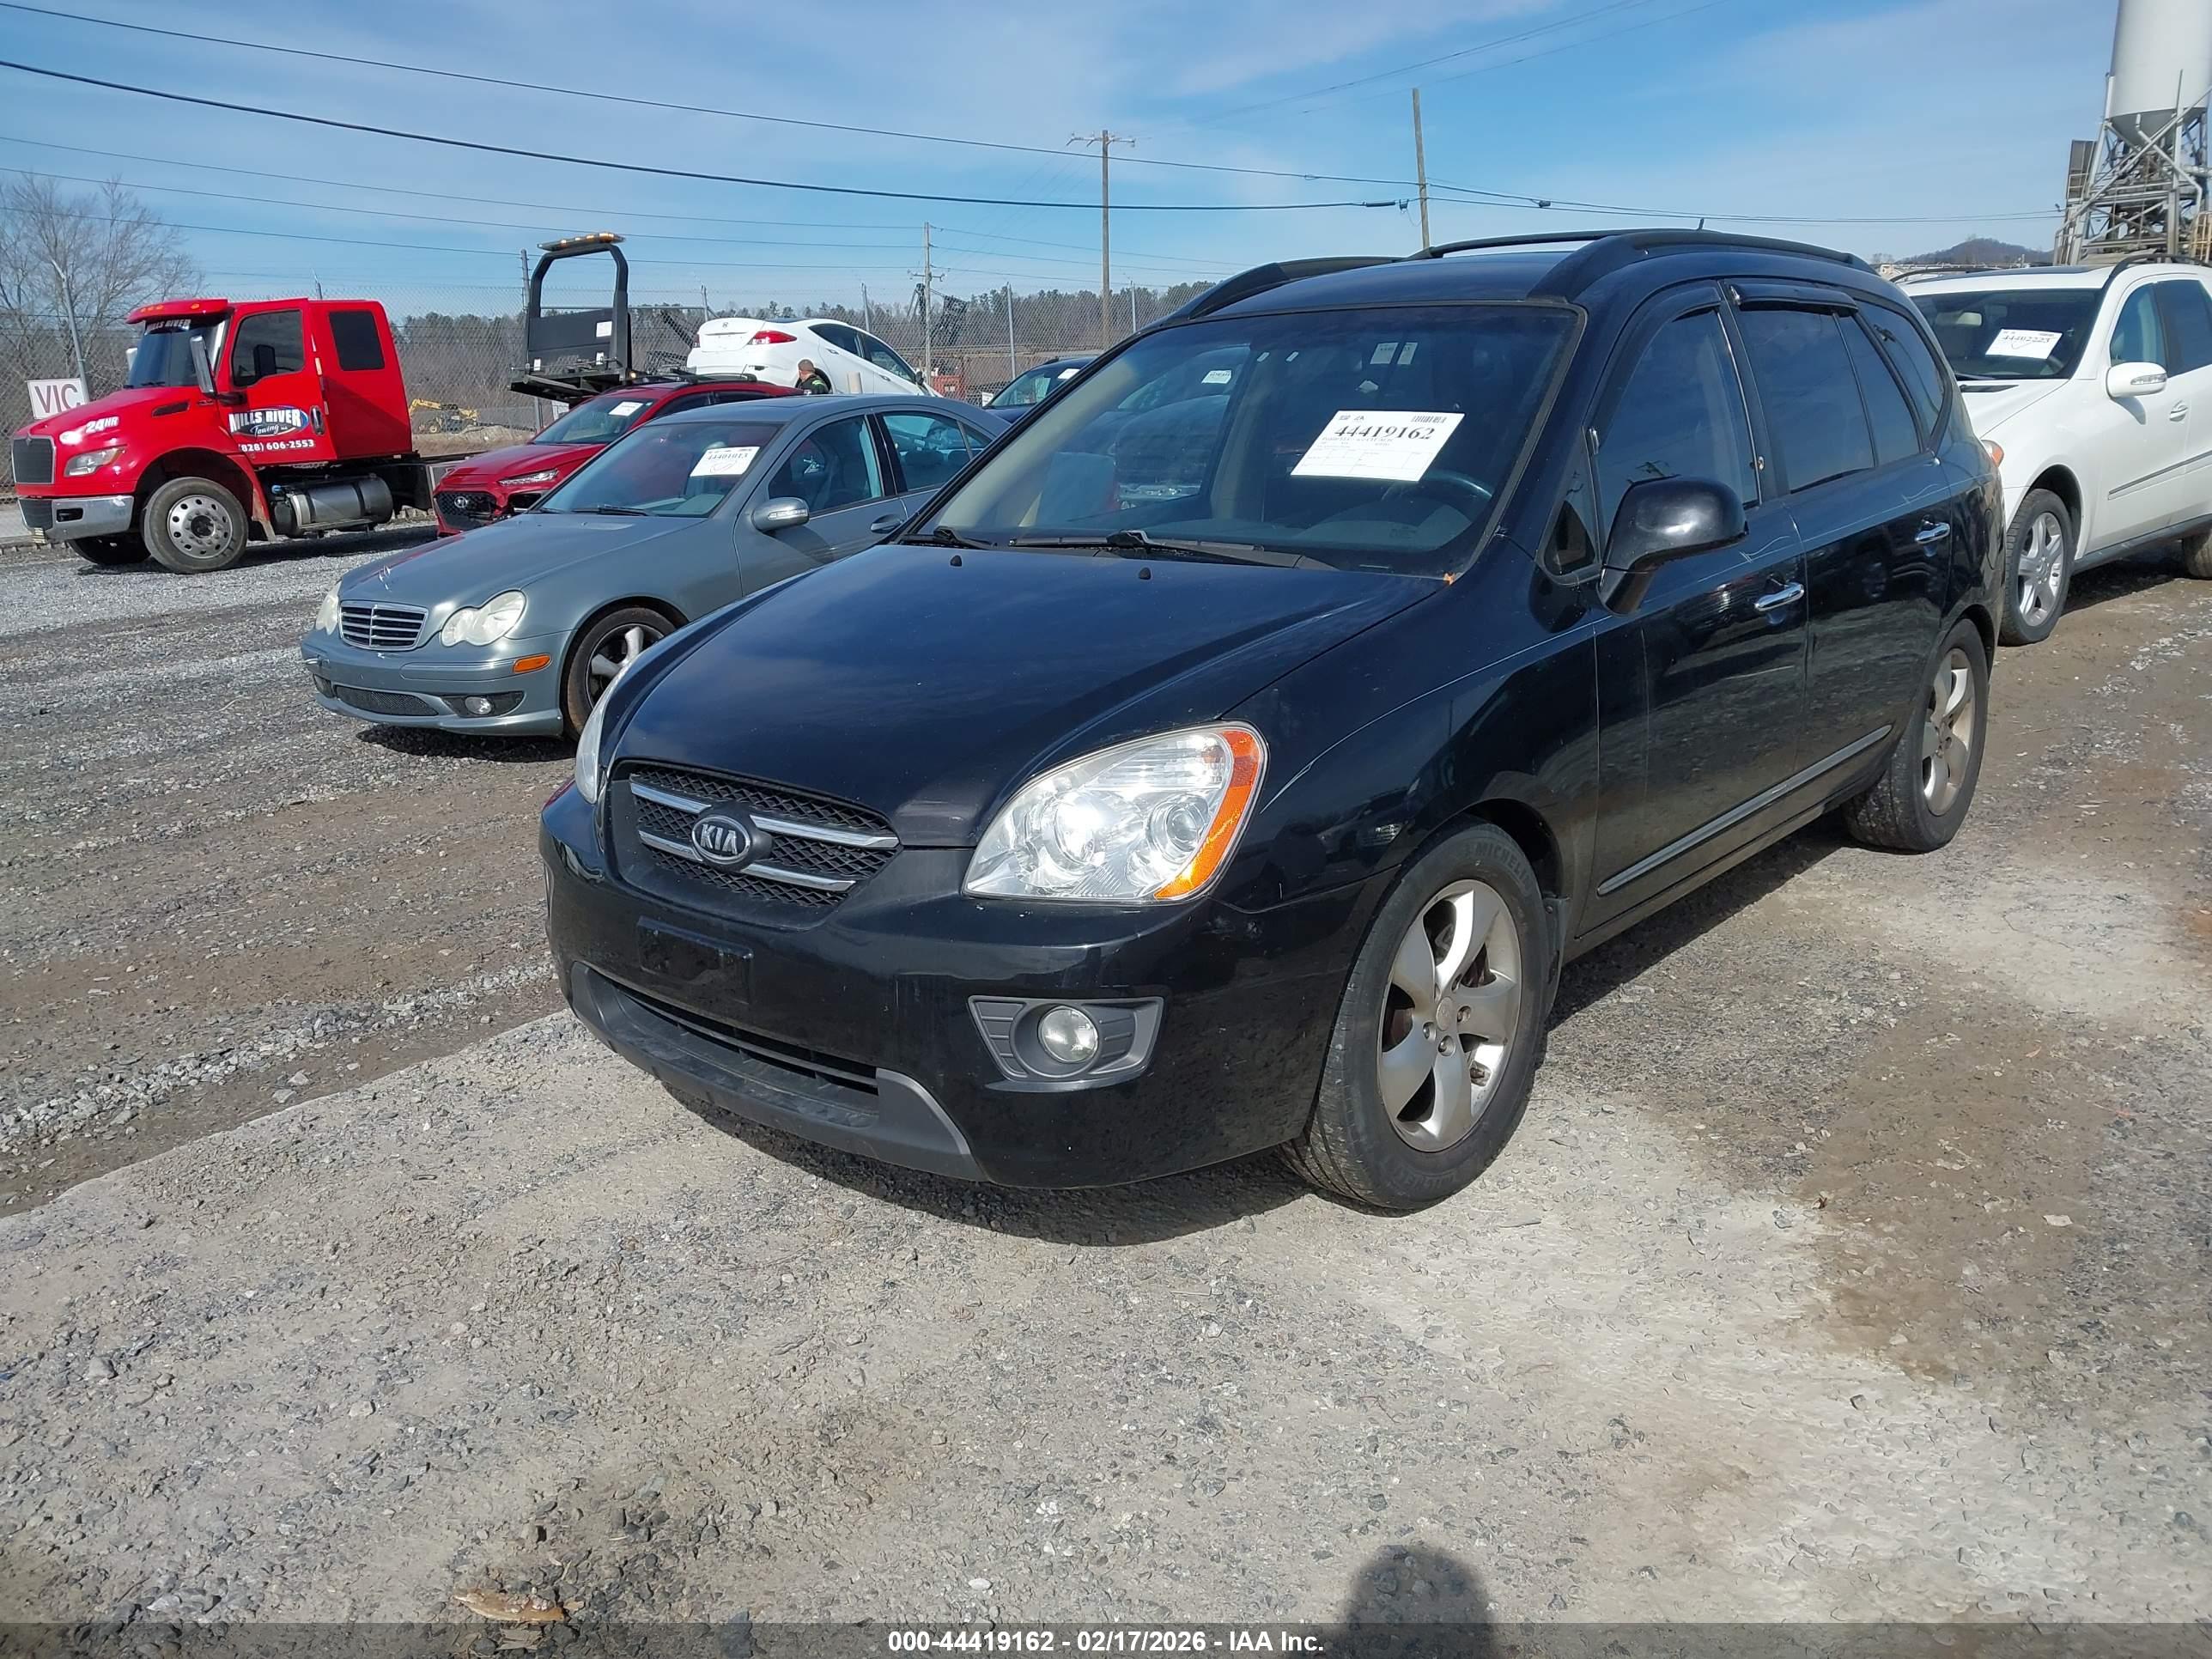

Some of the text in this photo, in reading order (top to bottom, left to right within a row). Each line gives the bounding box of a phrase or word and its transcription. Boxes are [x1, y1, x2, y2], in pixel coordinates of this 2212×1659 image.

[228, 409, 301, 433] MILLS RIVER
[250, 424, 279, 438] Towing
[1334, 425, 1435, 440] 44419162
[266, 439, 315, 451] 606-2553
[701, 824, 738, 855] KIA
